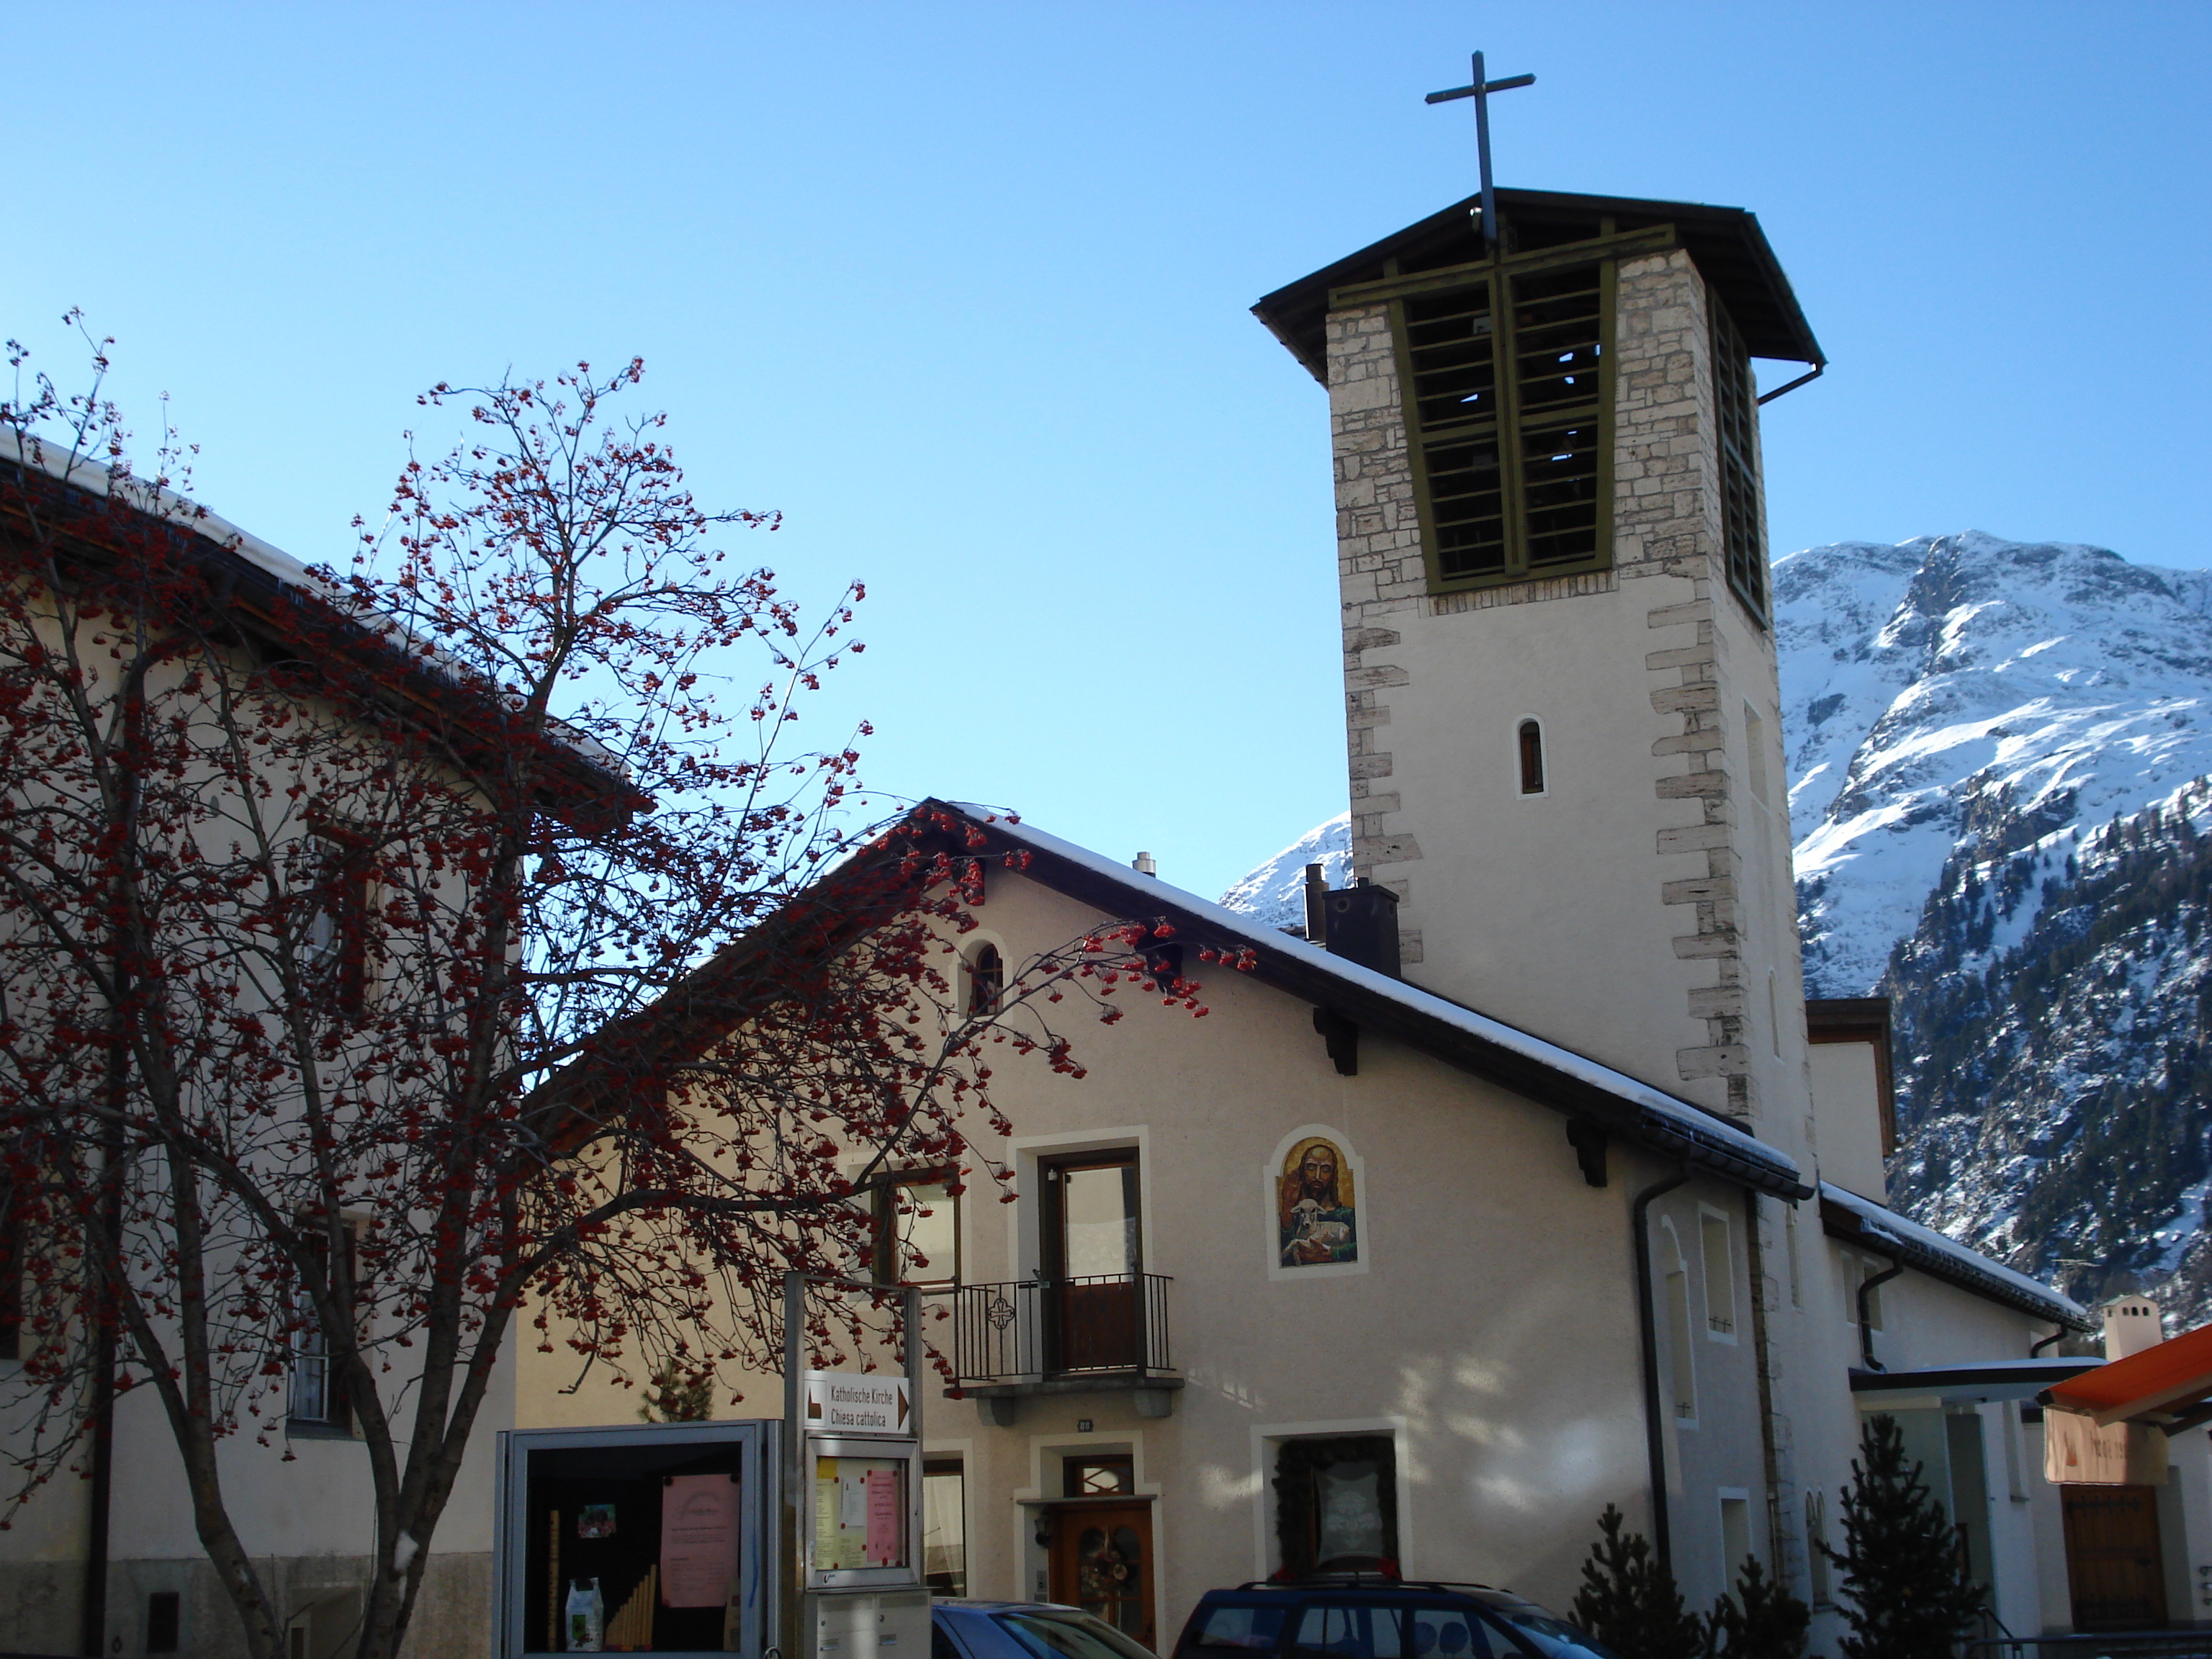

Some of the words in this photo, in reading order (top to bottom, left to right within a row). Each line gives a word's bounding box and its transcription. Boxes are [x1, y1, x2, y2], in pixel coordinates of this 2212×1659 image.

[831, 1385, 871, 1404] Katholische
[871, 1388, 893, 1405] Kirche
[831, 1408, 854, 1426] Chiesa
[856, 1411, 886, 1426] cattolica
